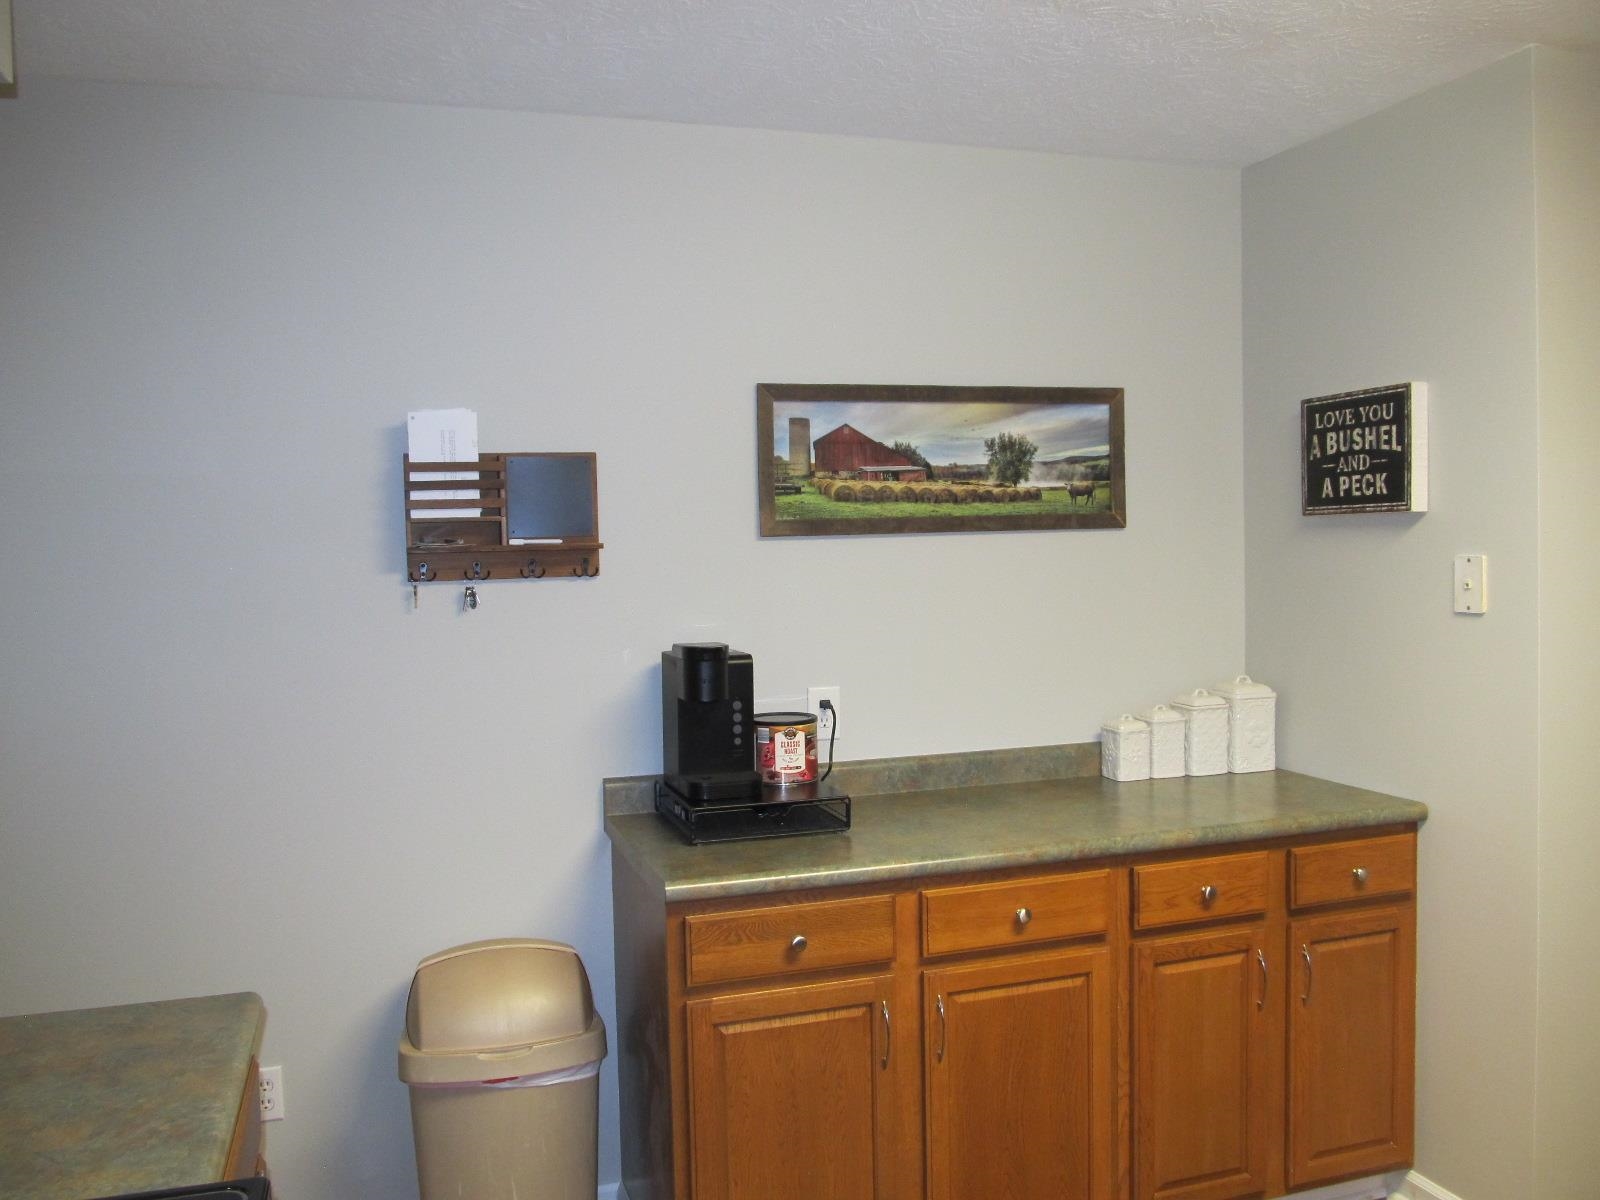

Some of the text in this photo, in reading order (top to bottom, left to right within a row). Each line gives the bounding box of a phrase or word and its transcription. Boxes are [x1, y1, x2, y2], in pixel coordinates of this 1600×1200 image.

[1315, 403, 1394, 429] LOVE YOU
[1310, 424, 1402, 461] A BUSHEL
[1337, 454, 1370, 473] AND
[1322, 472, 1388, 499] A PECK
